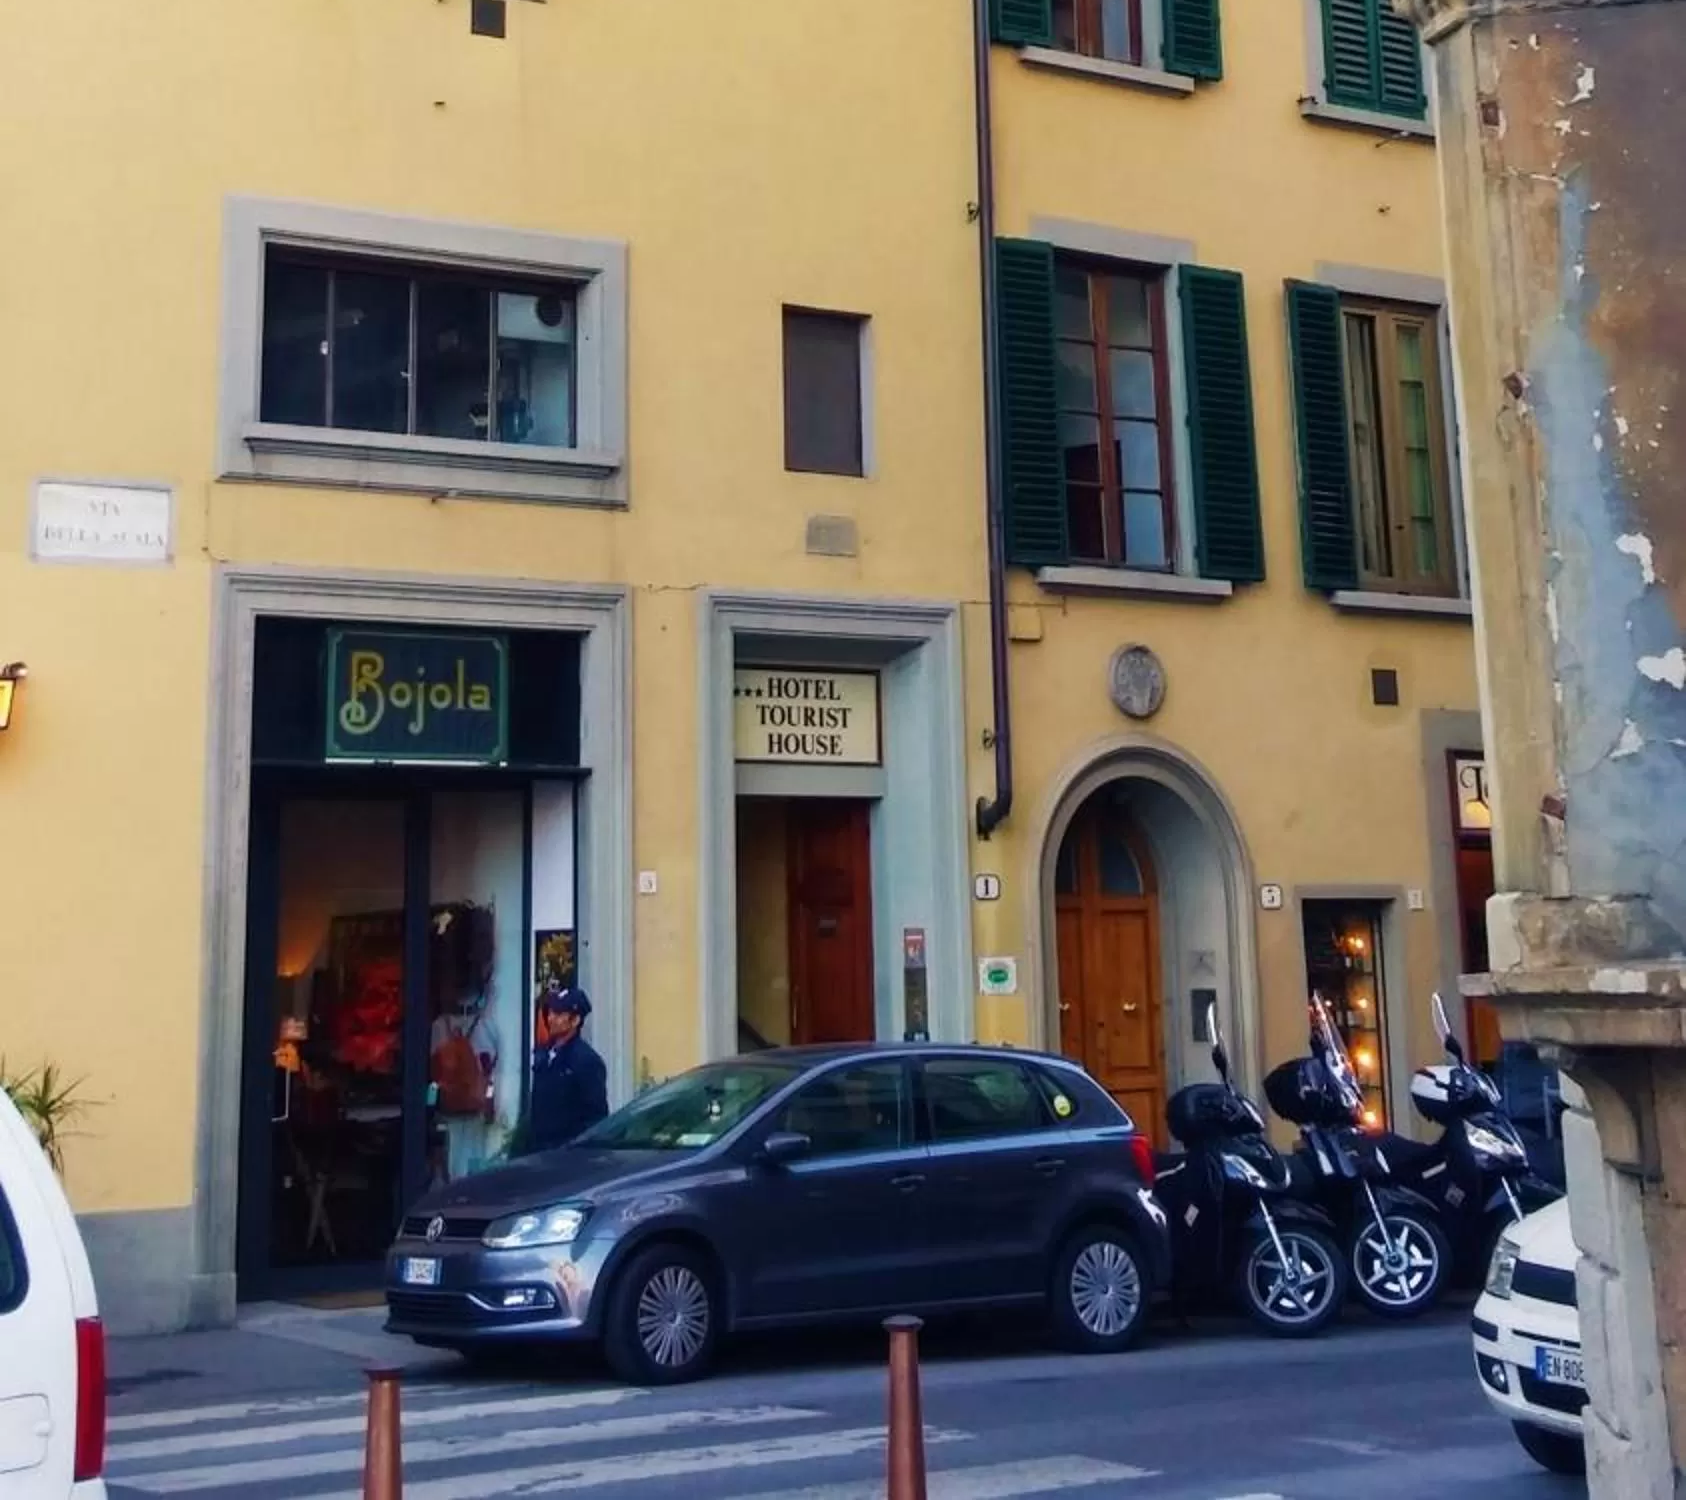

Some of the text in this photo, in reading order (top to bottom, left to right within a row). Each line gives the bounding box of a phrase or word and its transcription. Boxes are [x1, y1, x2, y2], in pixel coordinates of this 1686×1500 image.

[339, 651, 492, 735] Bojola
[767, 677, 841, 701] HOTEL
[756, 703, 852, 729] TOURIST
[767, 732, 843, 757] HOUSE
[1546, 1355, 1560, 1377] EN
